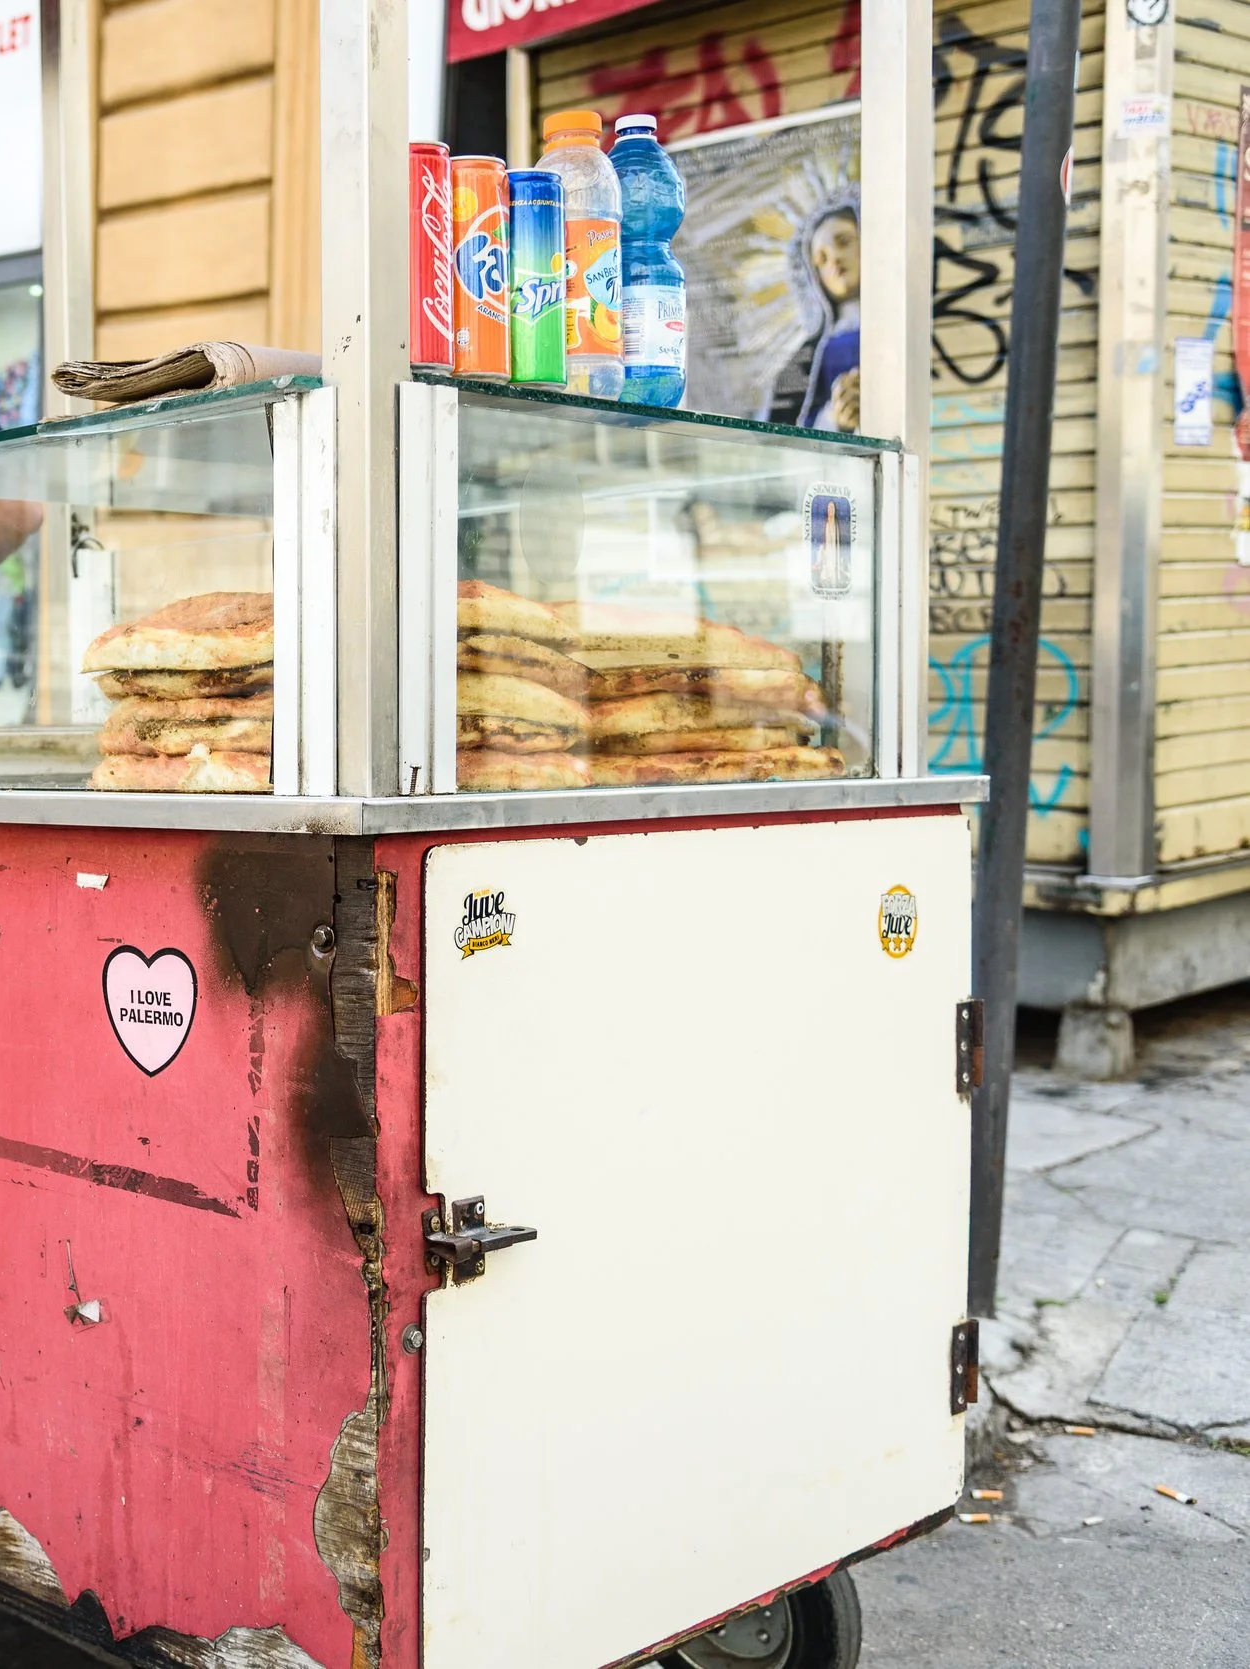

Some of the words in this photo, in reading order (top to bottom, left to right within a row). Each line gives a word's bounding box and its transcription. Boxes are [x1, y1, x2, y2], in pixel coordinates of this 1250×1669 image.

[463, 892, 504, 925] Juve
[881, 912, 913, 938] Juve
[130, 989, 134, 1004] I
[137, 990, 172, 1006] LOVE
[120, 1008, 184, 1027] PALERMO
